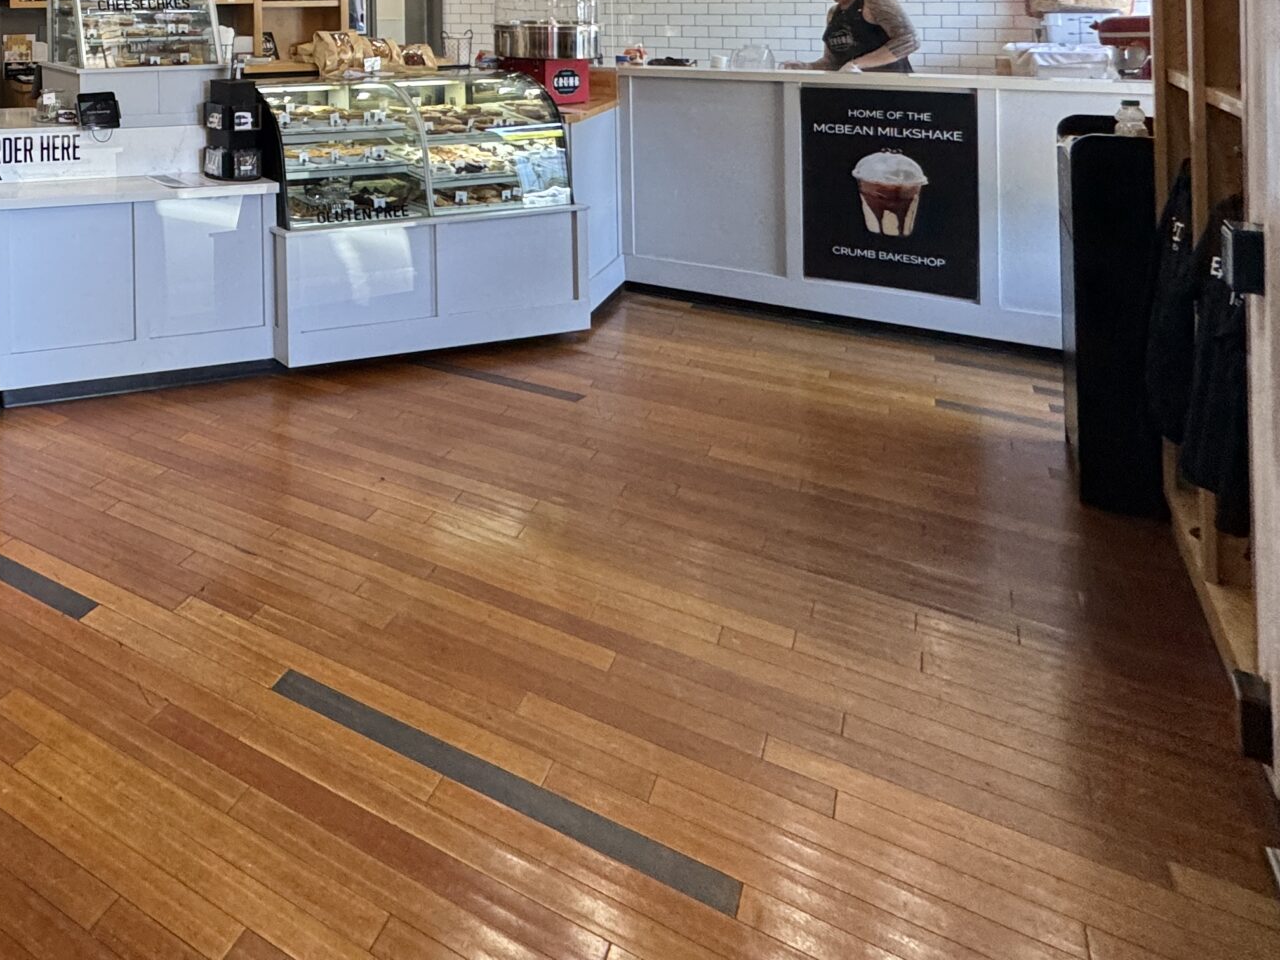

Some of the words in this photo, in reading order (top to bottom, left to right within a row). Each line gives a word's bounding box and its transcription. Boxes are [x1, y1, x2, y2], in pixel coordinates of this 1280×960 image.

[553, 76, 580, 87] CRUMB
[848, 108, 884, 120] HOME
[886, 111, 904, 120] OF
[906, 111, 932, 122] THE
[813, 123, 874, 136] MCBEAN
[877, 127, 964, 142] MILKSHAKE
[40, 134, 81, 162] HERE
[316, 209, 373, 224] GLUTEN
[375, 205, 410, 220] FREE
[832, 246, 876, 259] CRUMB
[878, 251, 946, 268] BAKESHOP
